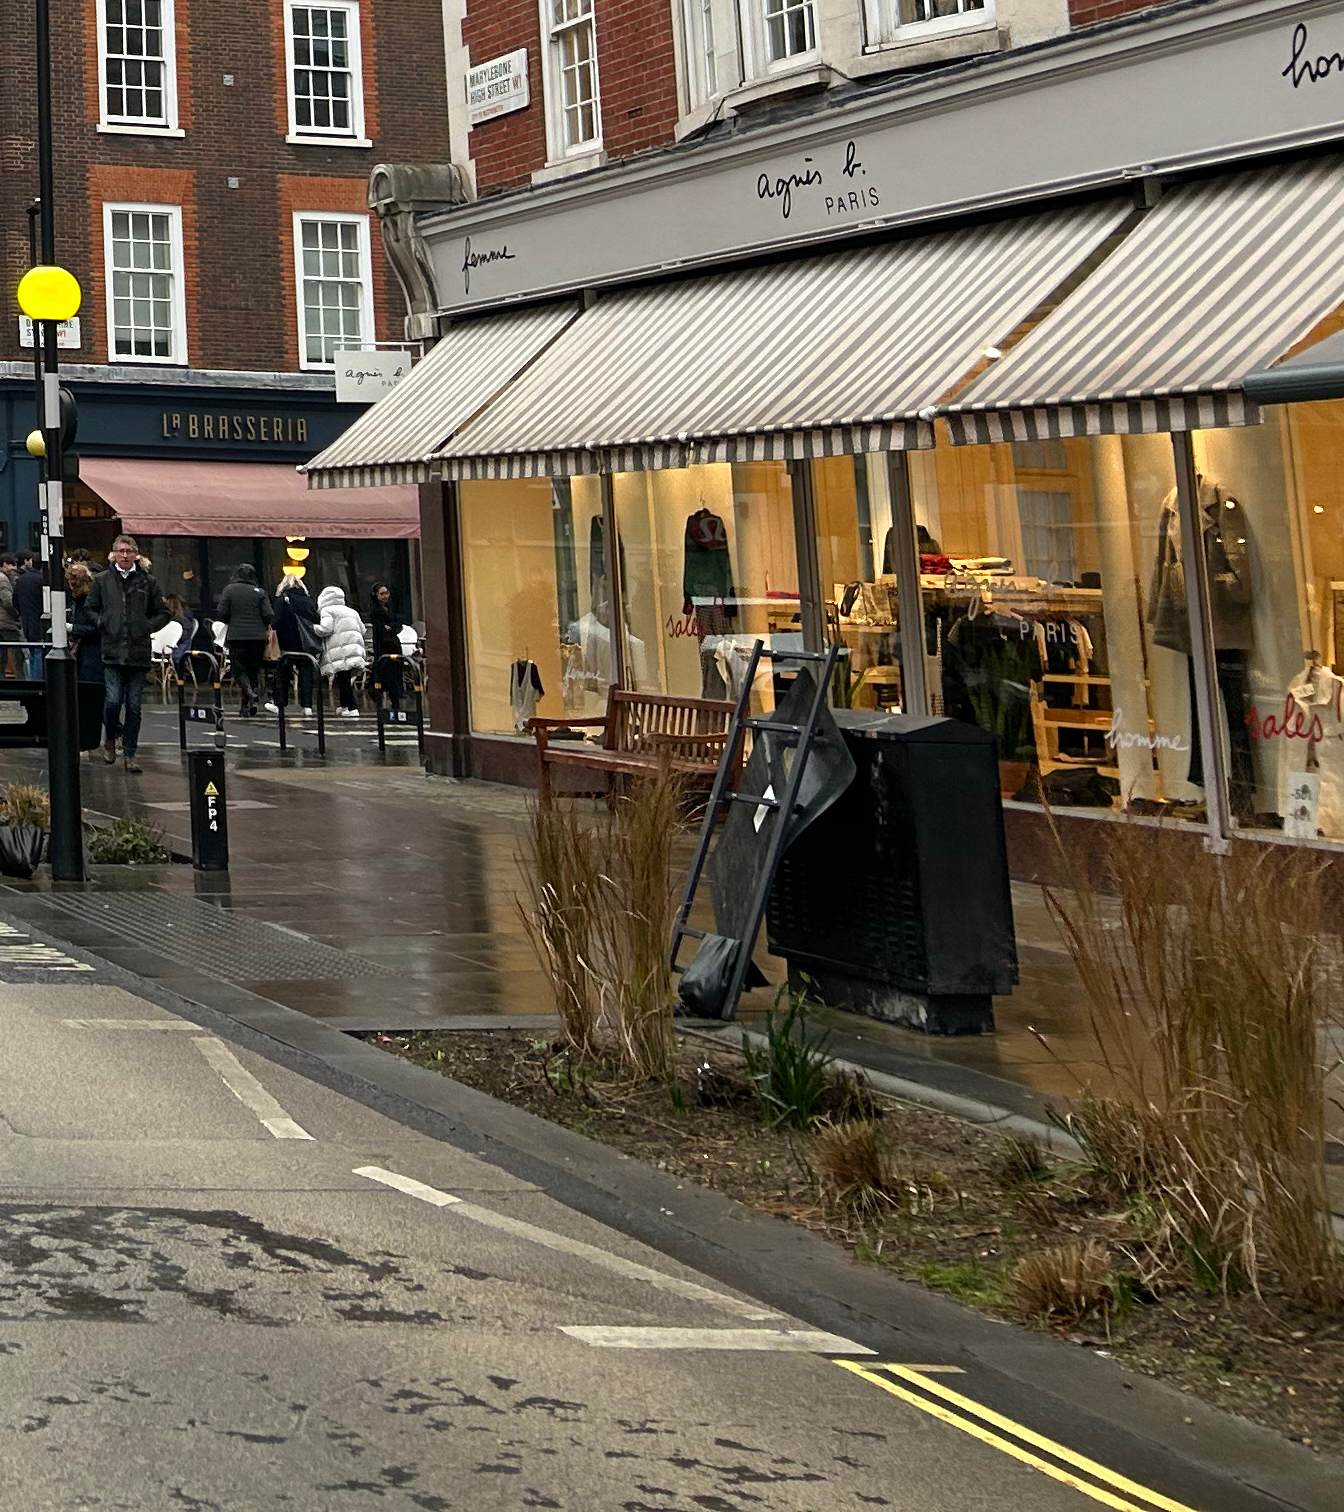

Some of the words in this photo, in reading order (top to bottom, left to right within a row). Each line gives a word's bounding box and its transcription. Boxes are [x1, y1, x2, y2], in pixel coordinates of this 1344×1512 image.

[469, 60, 512, 87] MARYLEBONE
[487, 78, 510, 99] STREET
[842, 140, 866, 177] b.
[825, 186, 879, 215] PARIS
[461, 236, 516, 295] femme
[188, 414, 308, 442] BRASSERIA
[1104, 707, 1190, 752] homme
